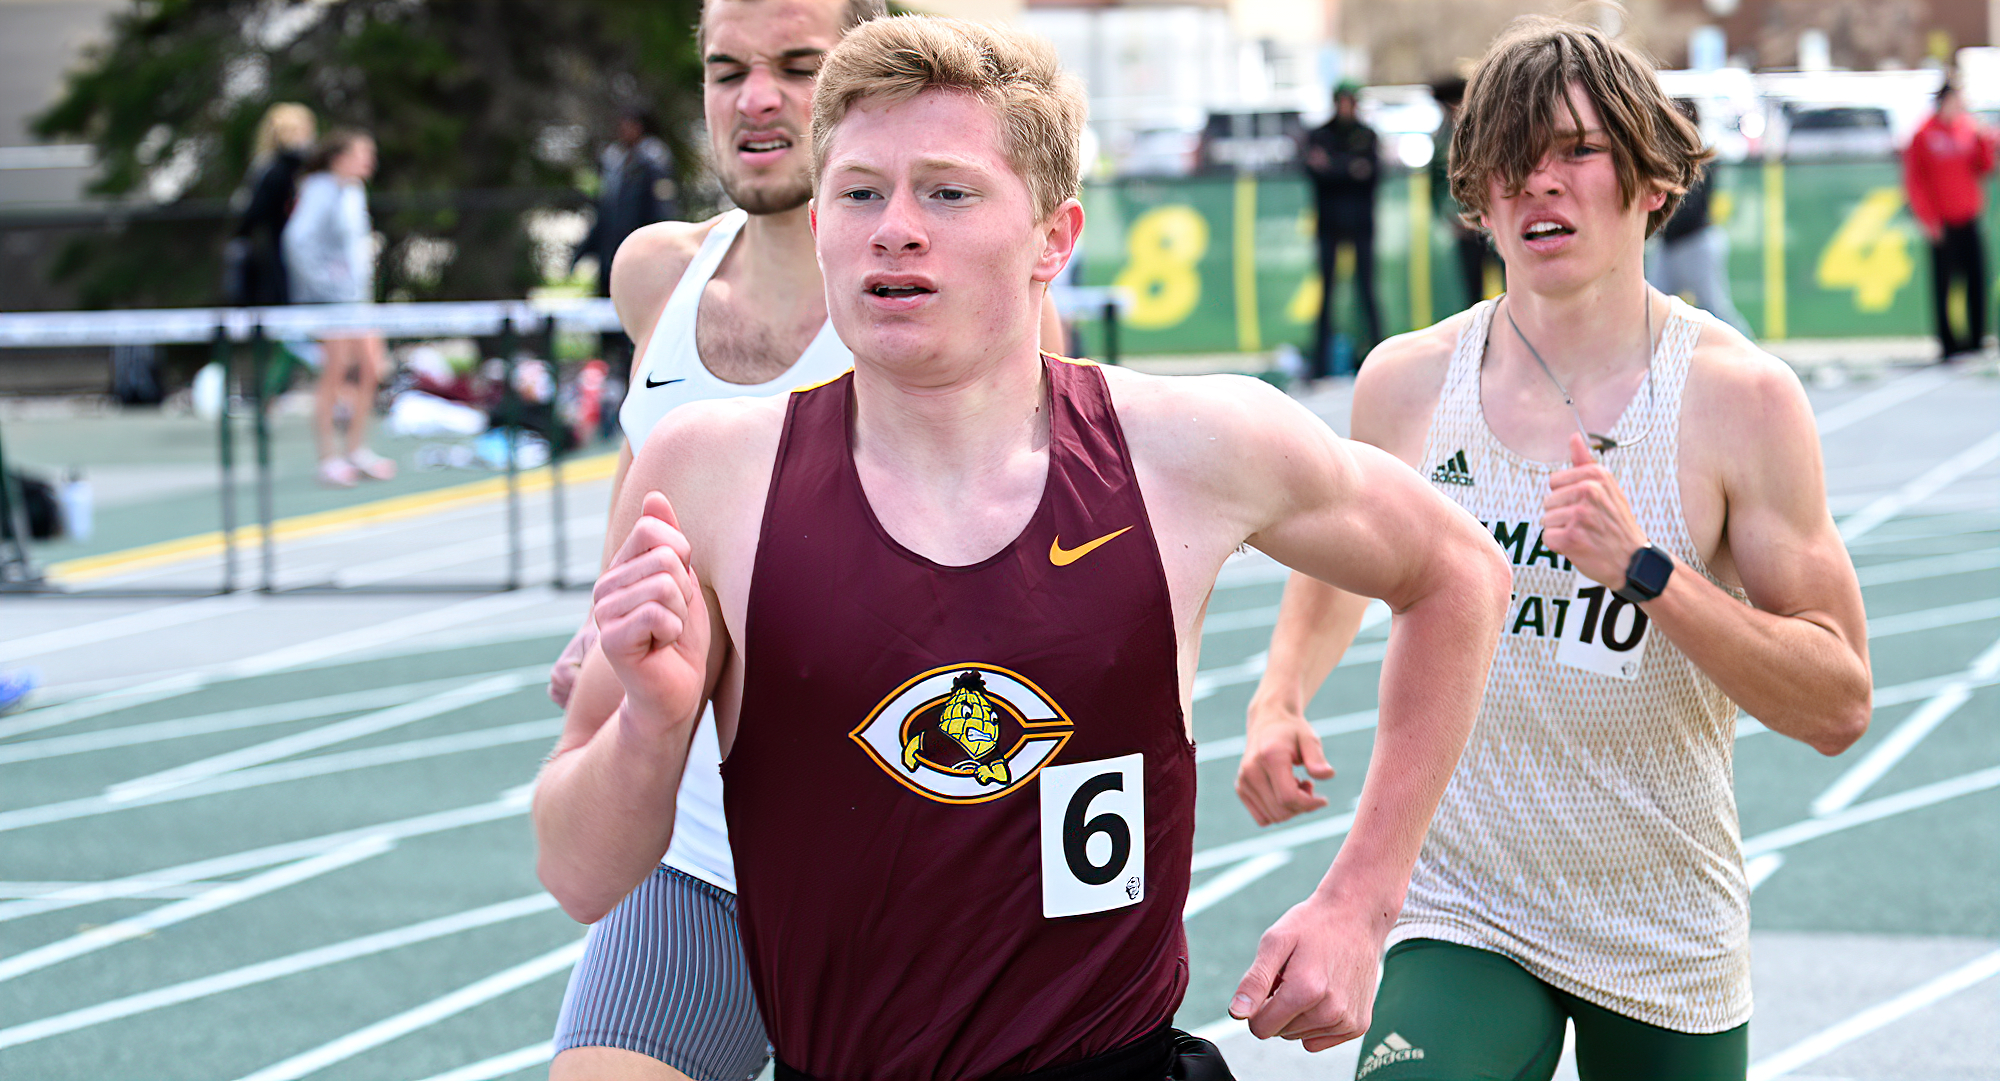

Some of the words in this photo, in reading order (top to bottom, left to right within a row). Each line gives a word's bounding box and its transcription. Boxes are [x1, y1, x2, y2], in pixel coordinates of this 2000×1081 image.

[1112, 206, 1208, 330] 8
[1816, 187, 1914, 313] 4
[1431, 471, 1475, 486] adidas
[1480, 521, 1572, 572] MA
[1511, 594, 1571, 638] AT
[1577, 585, 1649, 652] 10
[1062, 771, 1132, 886] 6
